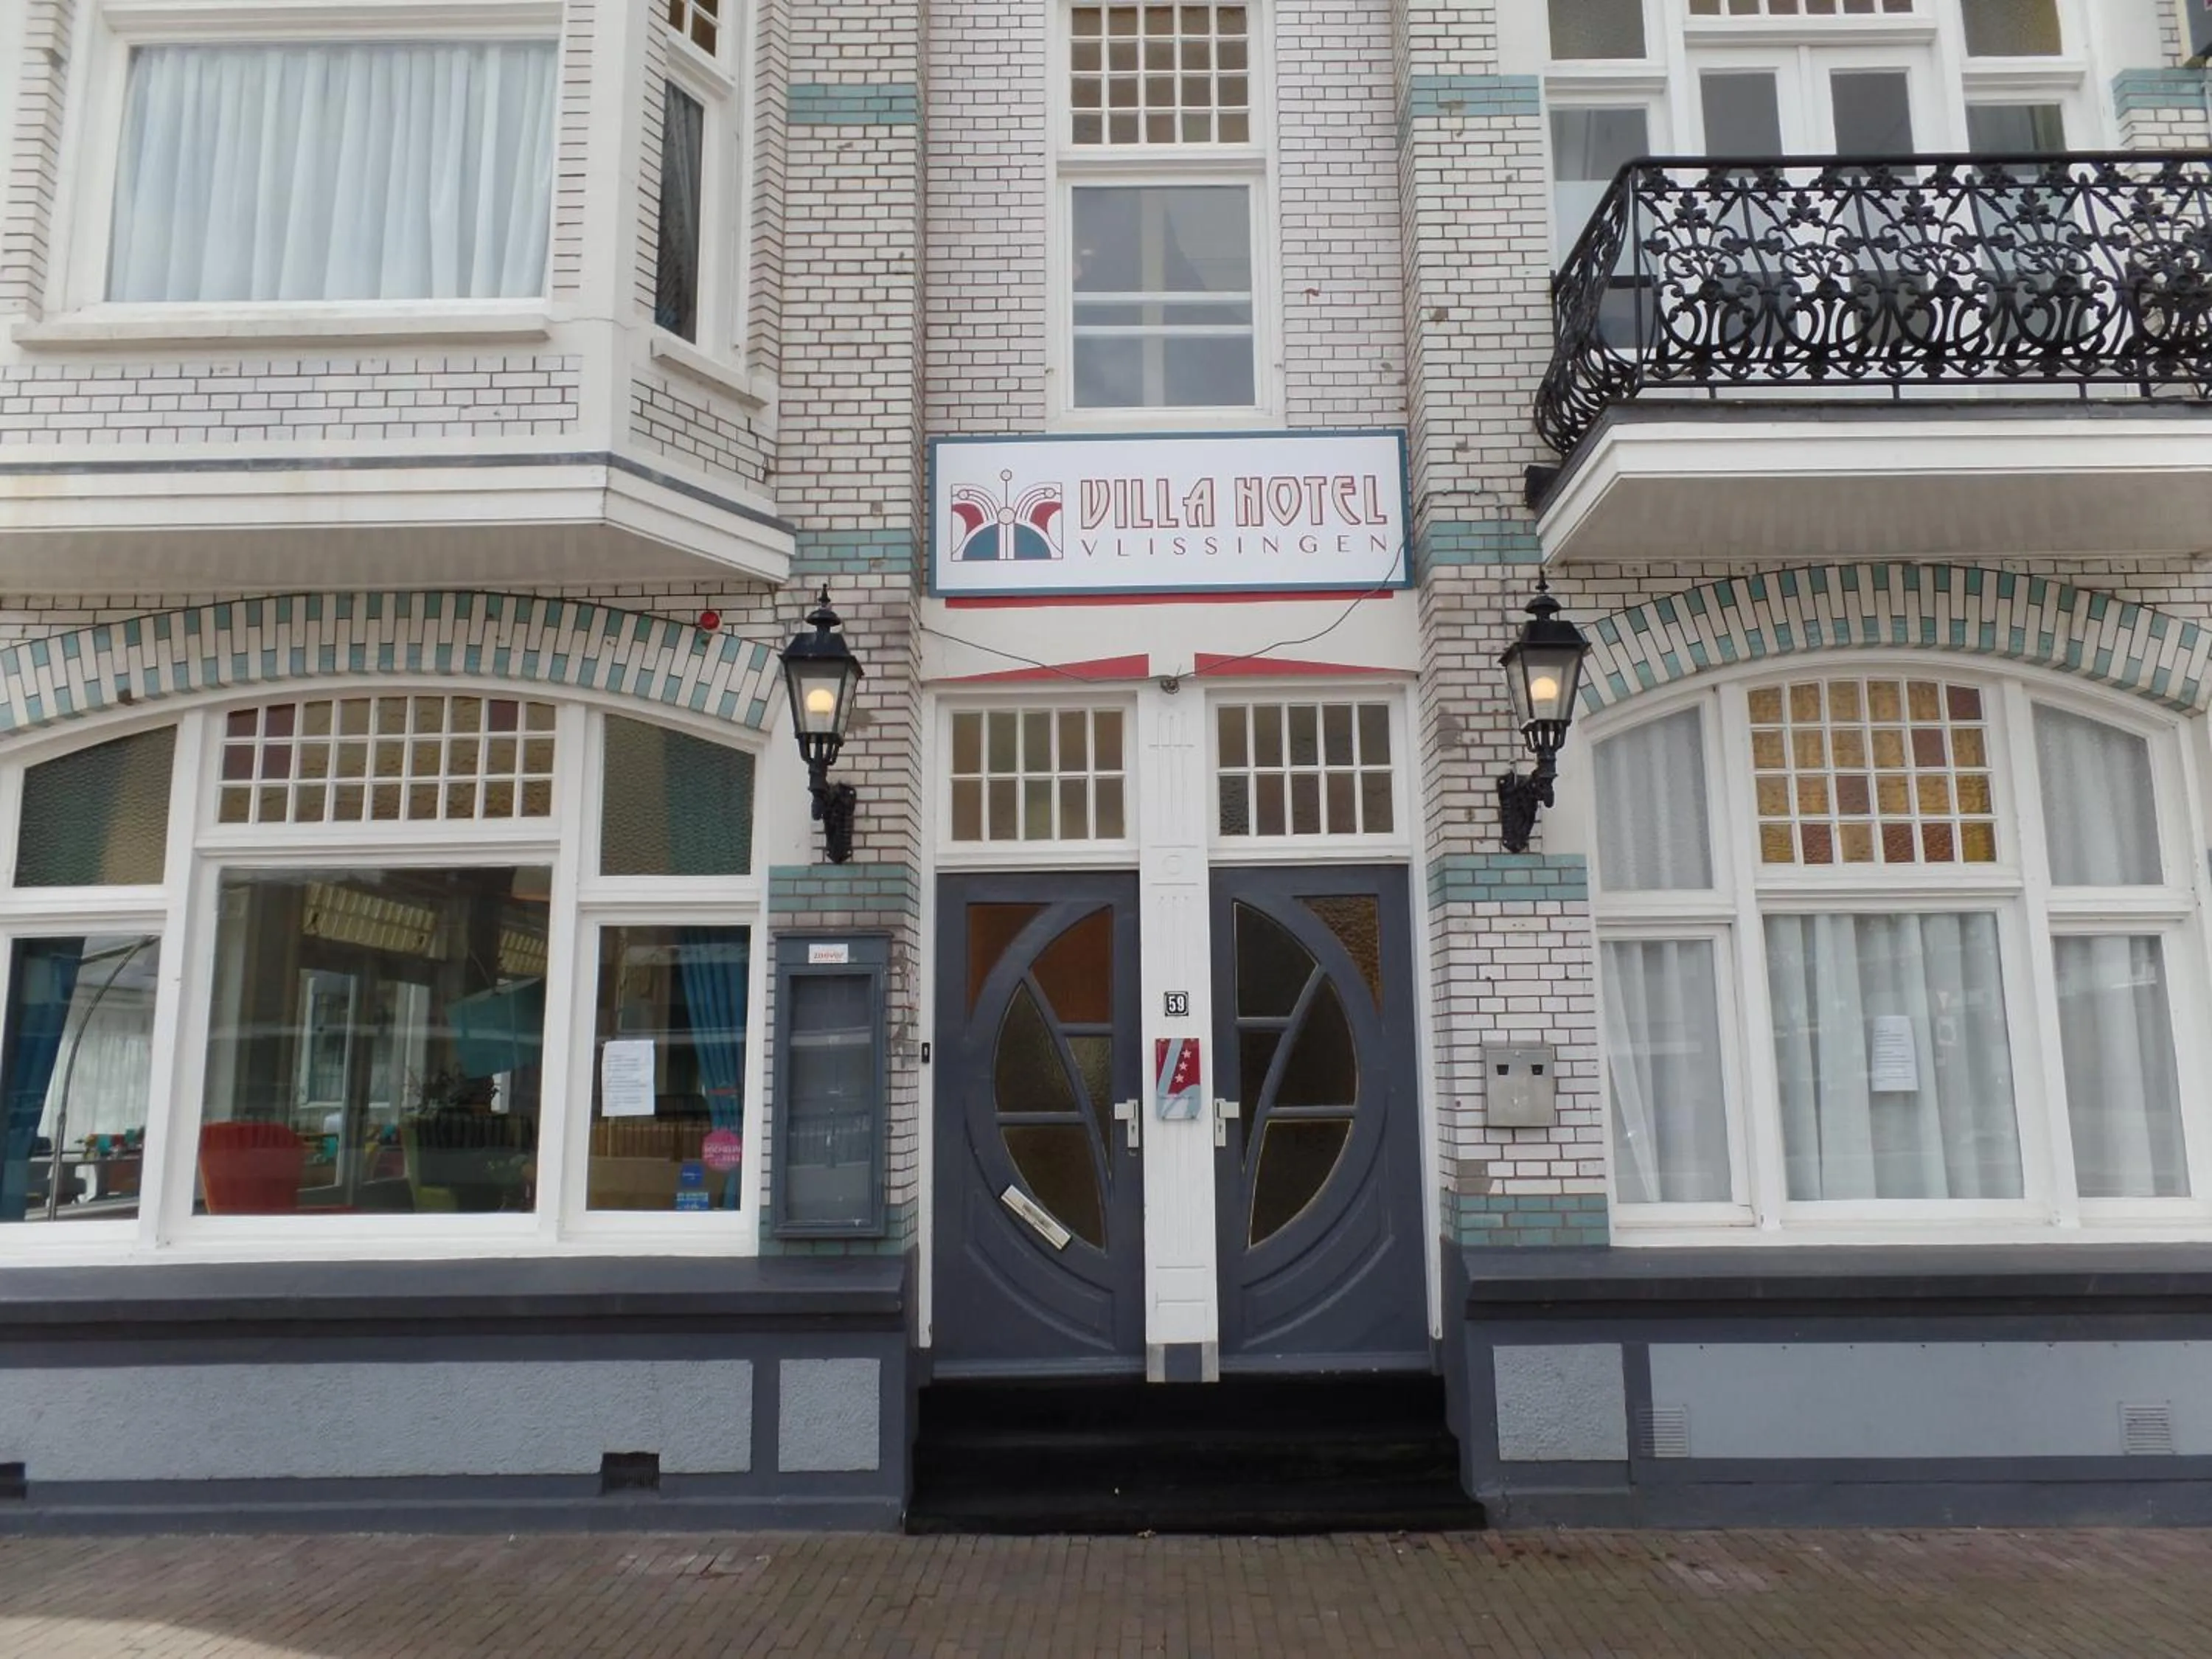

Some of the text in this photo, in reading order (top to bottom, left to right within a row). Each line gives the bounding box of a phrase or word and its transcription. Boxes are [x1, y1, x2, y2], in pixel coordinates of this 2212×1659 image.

[1080, 476, 1388, 529] VILLA HOTEL
[1081, 535, 1387, 557] VLISSINGEN
[1169, 996, 1184, 1012] 59
